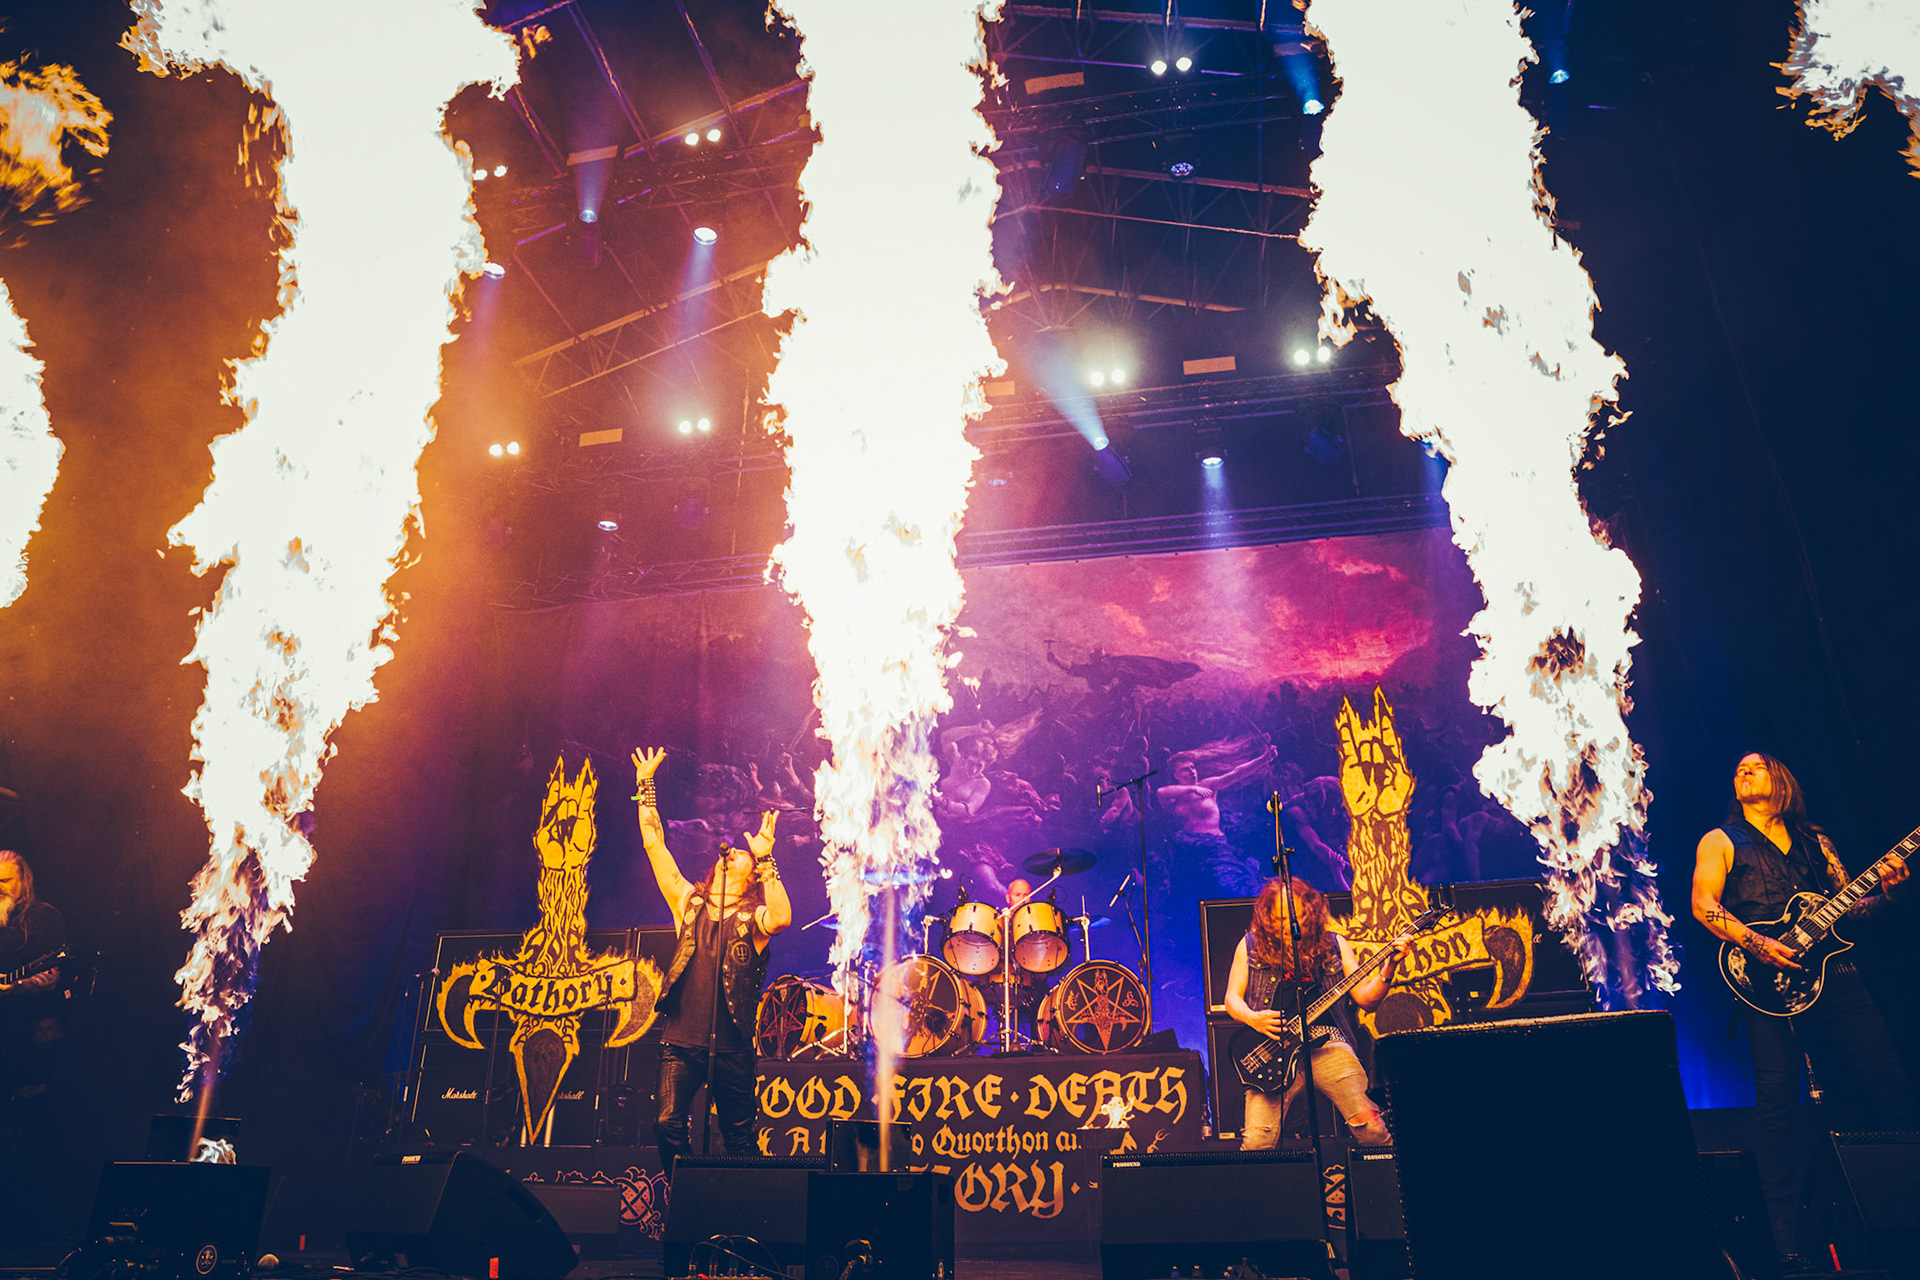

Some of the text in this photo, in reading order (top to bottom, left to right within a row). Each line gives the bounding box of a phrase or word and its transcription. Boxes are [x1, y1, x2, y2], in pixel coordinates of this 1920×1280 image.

[480, 964, 614, 1013] Bathory
[754, 1066, 1188, 1130] OOD FIRE DEATH
[931, 1124, 1049, 1160] Quorthon
